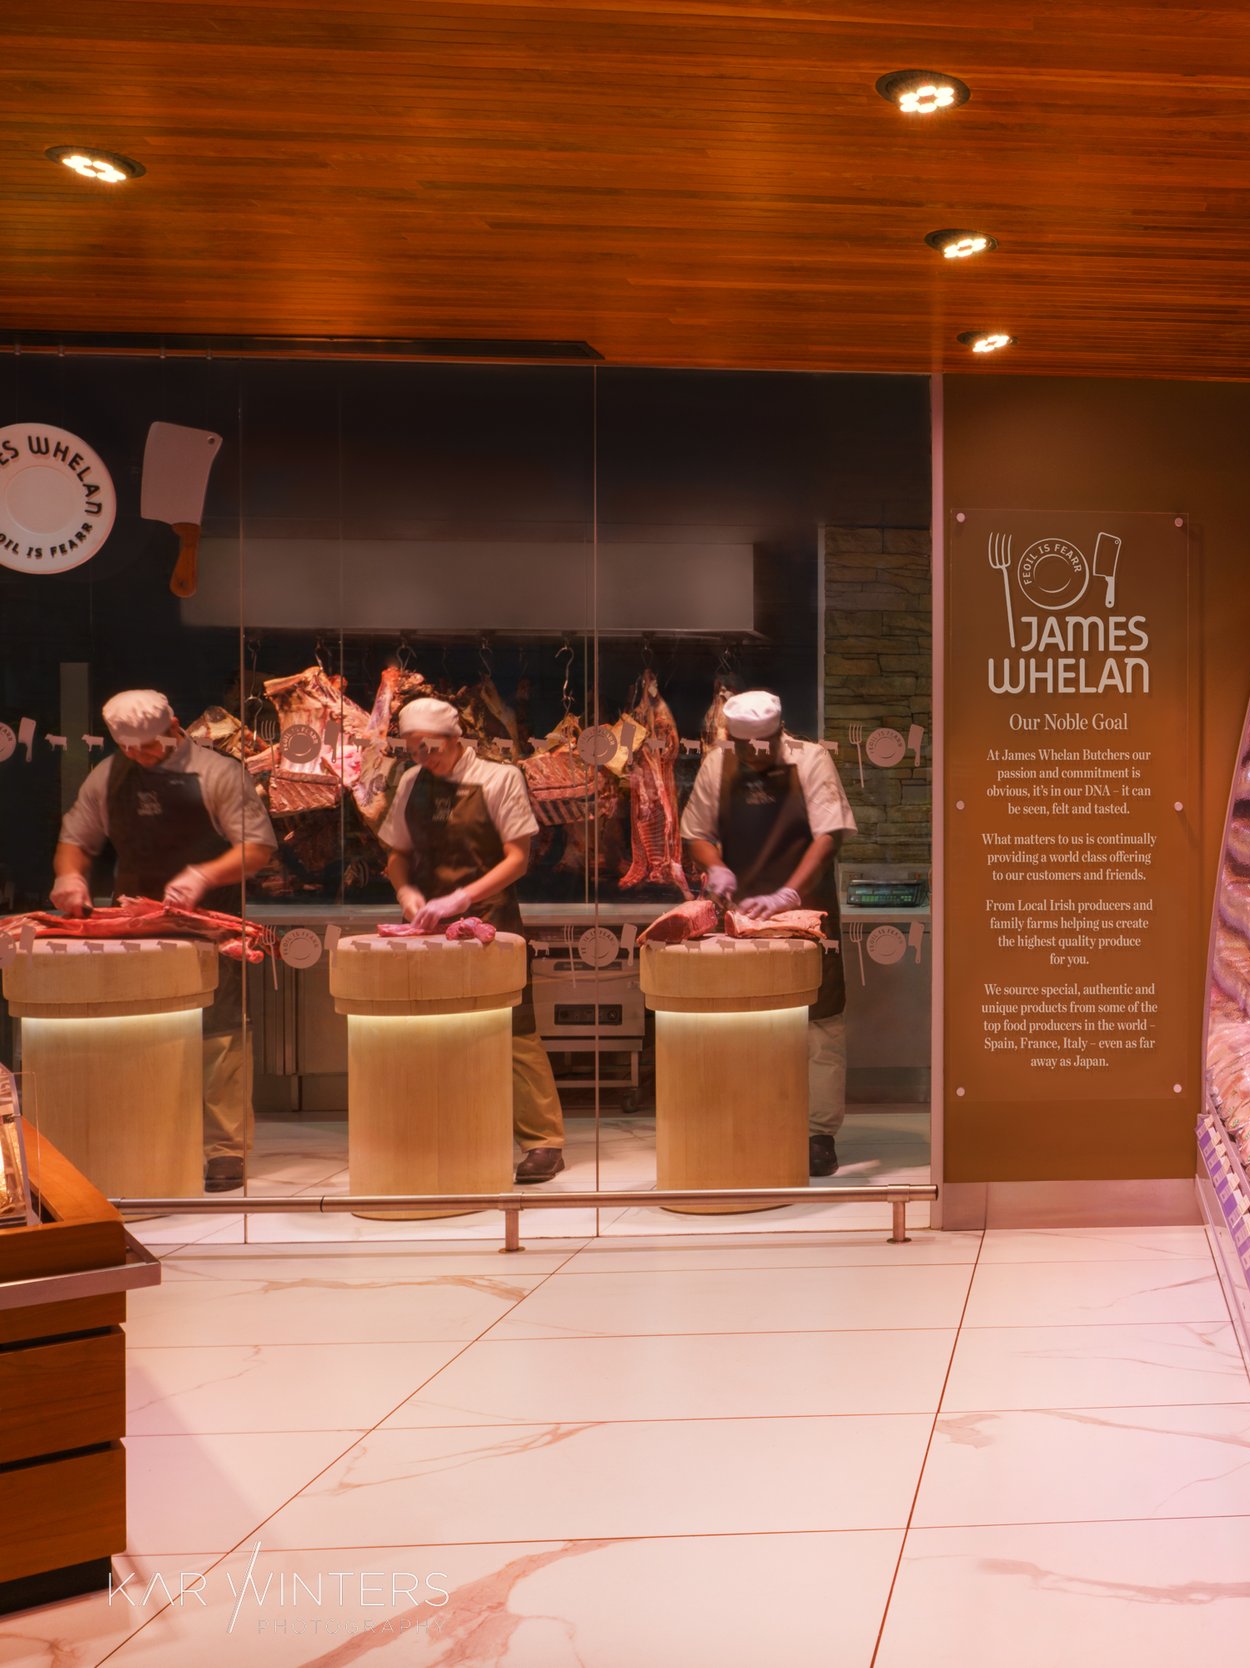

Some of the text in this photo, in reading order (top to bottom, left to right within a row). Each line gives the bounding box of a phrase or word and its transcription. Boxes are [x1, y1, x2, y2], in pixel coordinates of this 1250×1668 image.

[28, 435, 102, 518] WHELAN
[26, 547, 43, 559] IS
[50, 522, 93, 559] FEARR
[1023, 543, 1082, 586] FEOIL IS FEARR
[1020, 615, 1149, 652] JAMES
[988, 657, 1149, 694] WHELAN
[1009, 713, 1128, 731] Our Noble Goal
[986, 748, 1151, 761] At James Whelan Butchers our
[997, 766, 1141, 780] passion and commitment is
[987, 784, 1030, 798] obvious,
[1051, 785, 1061, 796] in
[1063, 788, 1083, 797] our
[1085, 785, 1111, 796] DNA
[1122, 784, 1130, 796] it
[1132, 788, 1151, 796] can
[1008, 802, 1130, 816] be seen, felt and tasted.
[981, 832, 1157, 847] What matters to us is continually
[987, 850, 1152, 865] providing a world class offering
[992, 868, 1146, 881] to our customers and friends.
[986, 899, 1153, 913] From Local Irish producers and
[990, 917, 1149, 931] family farms helping us create
[998, 935, 1141, 949] the highest quality produce
[1050, 953, 1089, 967] for you.
[984, 983, 1155, 998] We source special, authentic and
[981, 1001, 1158, 1016] unique products from some of the
[983, 1020, 1001, 1034] top
[1003, 1019, 1027, 1031] food
[1029, 1019, 1082, 1033] producers
[1084, 1019, 1095, 1031] in
[1097, 1019, 1115, 1031] the
[1117, 1018, 1147, 1030] world
[984, 1037, 1018, 1052] Spain,
[1020, 1037, 1060, 1050] France,
[1063, 1037, 1088, 1051] Italy
[1098, 1040, 1123, 1049] even
[1125, 1040, 1137, 1048] as
[1139, 1036, 1156, 1048] far
[1030, 1055, 1109, 1069] away as Japan.
